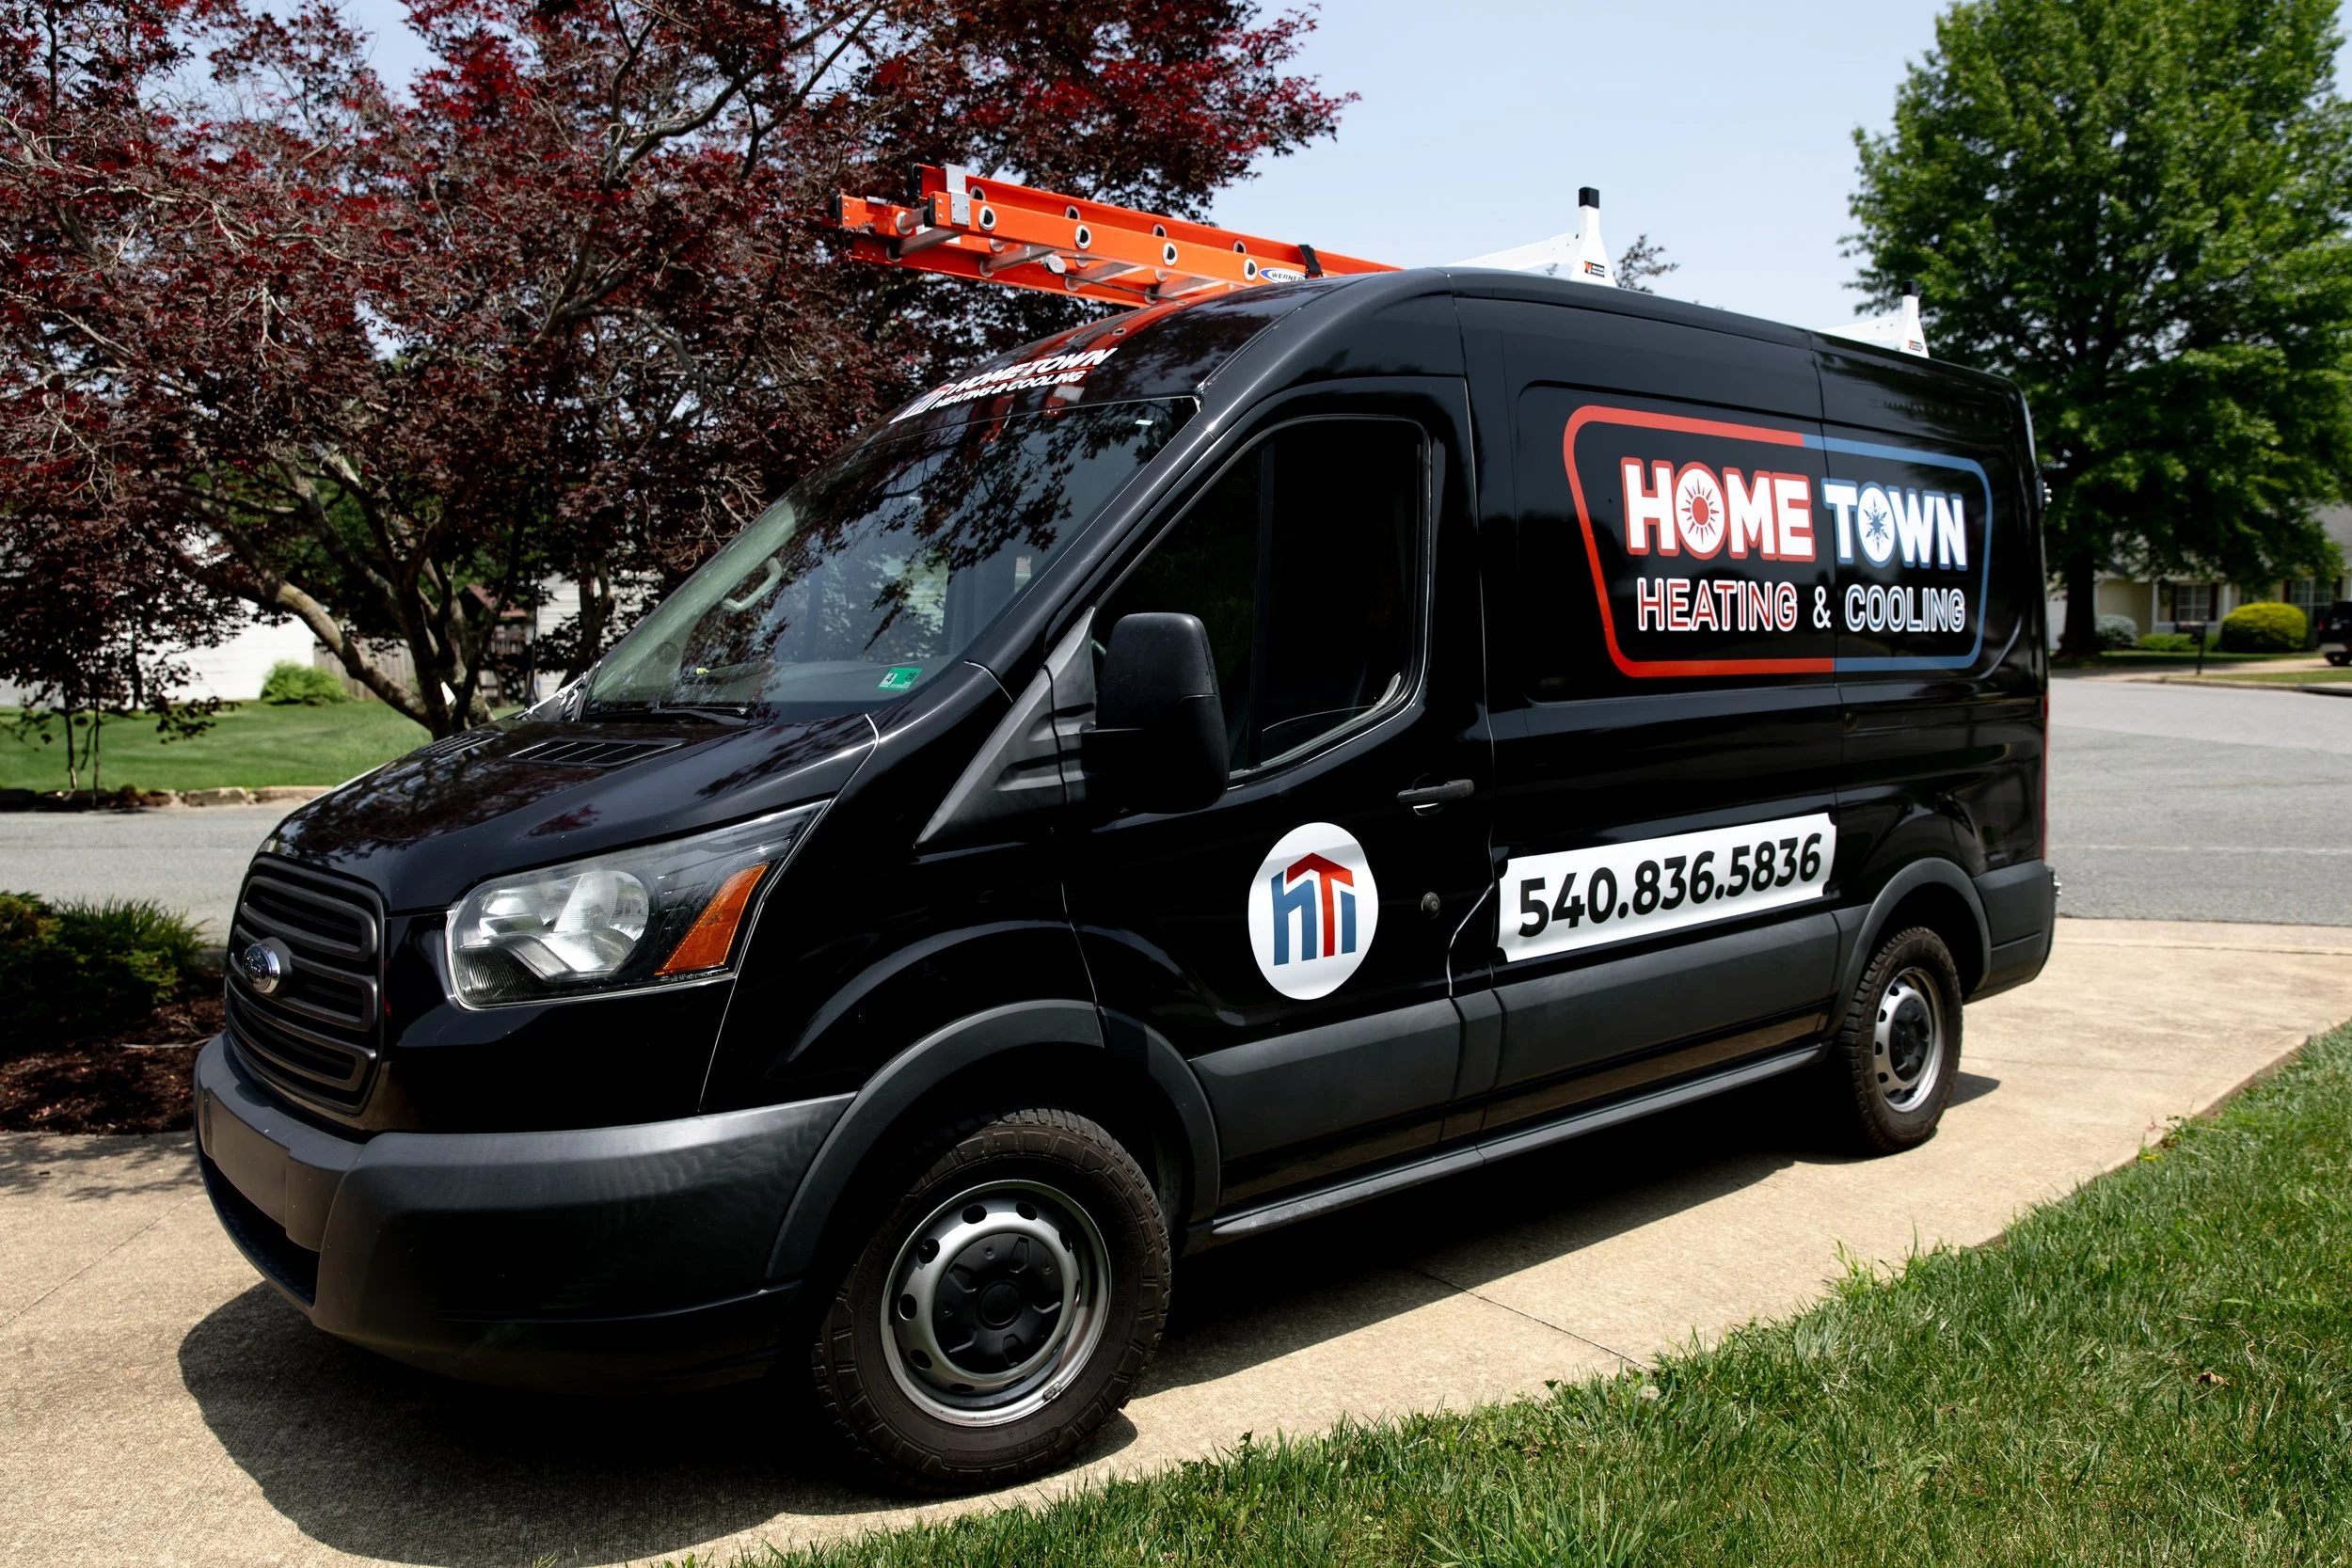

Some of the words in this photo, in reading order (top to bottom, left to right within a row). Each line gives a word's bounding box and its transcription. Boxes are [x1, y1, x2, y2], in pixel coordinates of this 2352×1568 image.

[930, 386, 995, 410] HEATING
[992, 383, 1009, 394] &
[1006, 371, 1087, 391] COOLING
[1621, 457, 1816, 562] HOME
[1821, 478, 1968, 571] TOWN
[1637, 577, 1798, 632] HEATING
[1813, 585, 1833, 628] &
[1844, 584, 1965, 633] COOLING
[1518, 832, 1822, 938] 540.836.5836
